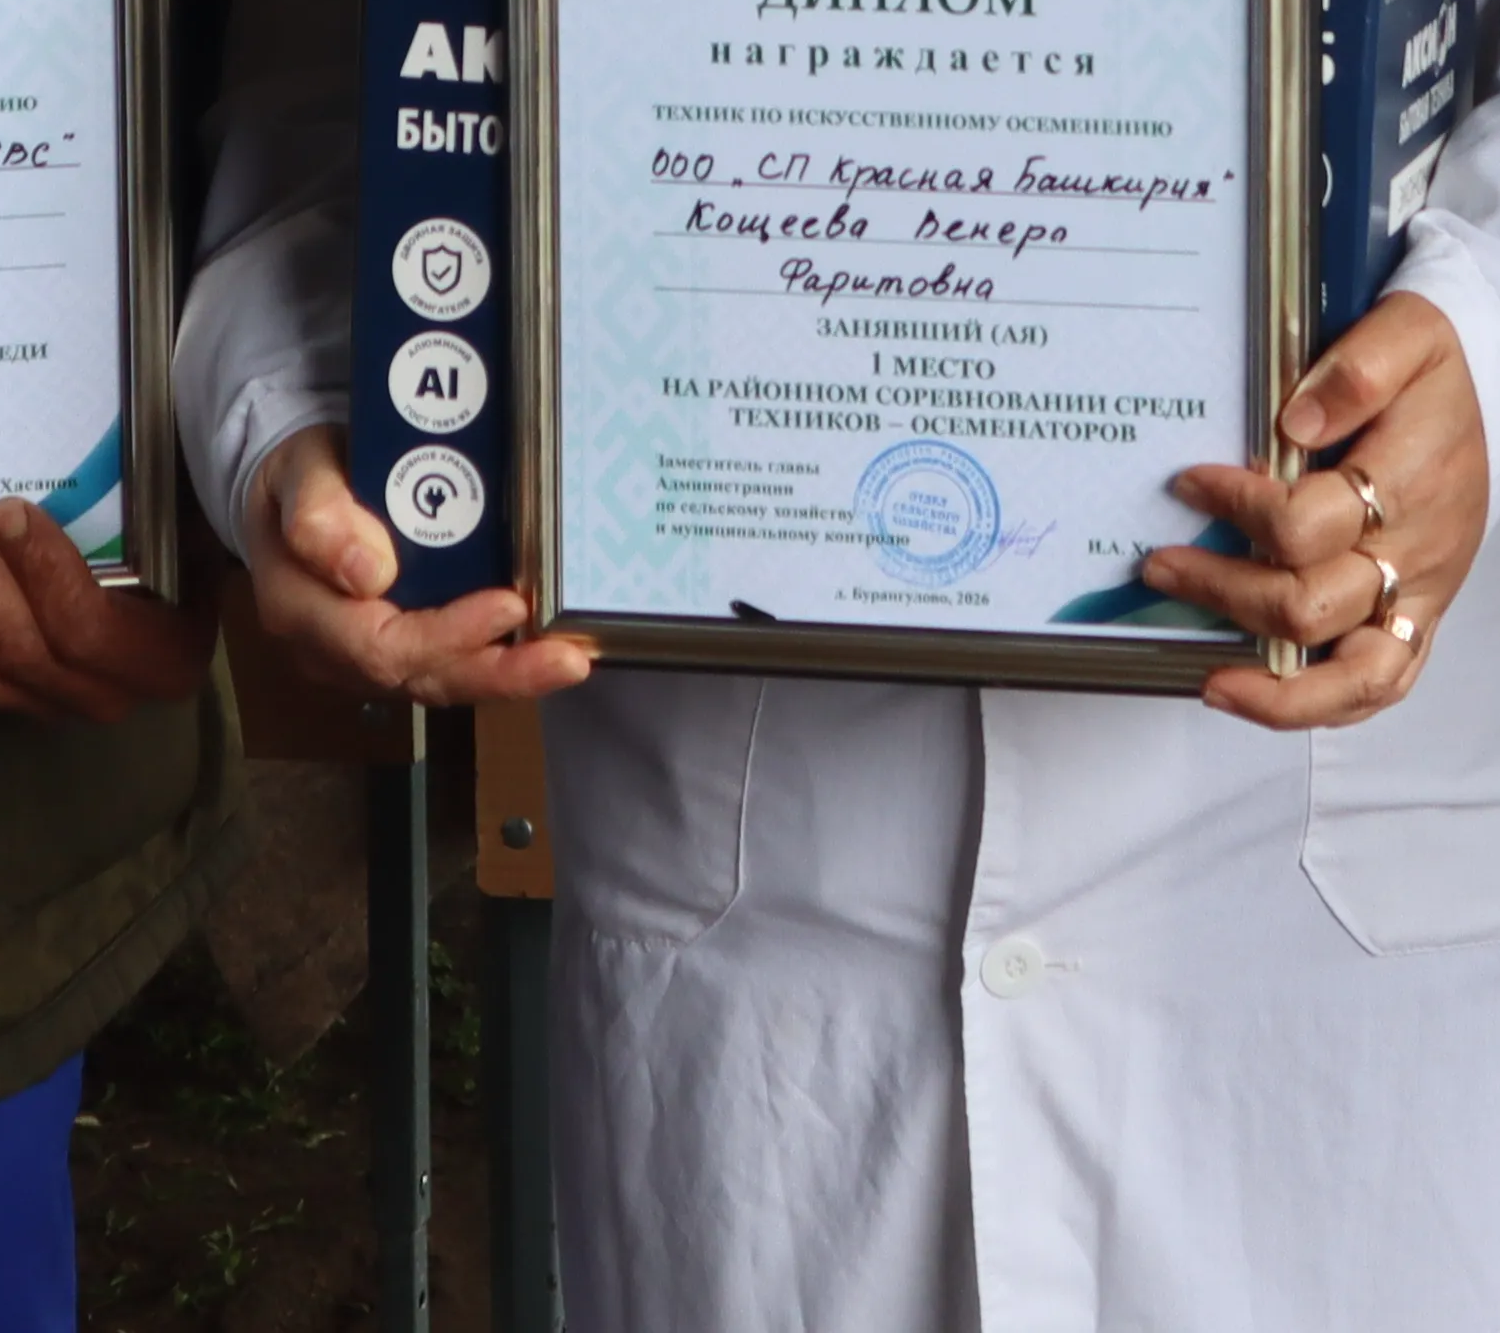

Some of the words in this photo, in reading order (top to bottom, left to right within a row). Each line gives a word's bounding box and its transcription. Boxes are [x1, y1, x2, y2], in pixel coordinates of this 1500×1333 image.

[400, 21, 503, 84] АК
[711, 42, 1094, 76] награждается
[397, 107, 504, 156] БЫТО
[652, 104, 745, 124] ТЕХНИК
[751, 107, 783, 124] ПО
[788, 108, 1001, 131] ИСКУССТВЕННОМУ
[1005, 116, 1173, 137] ОСЕМЕНЕНИЮ
[650, 153, 715, 183] ООО
[829, 157, 995, 201] Красная
[685, 199, 870, 243] Кощеева
[778, 256, 996, 307] Фаритовна
[816, 318, 982, 343] ЗАНЯВШИЙ
[990, 324, 1048, 347] (АЯ)
[872, 351, 881, 376] 1
[894, 356, 996, 380] МЕСТО
[662, 376, 700, 398] НА
[708, 377, 868, 404] РАЙОННОМ
[875, 386, 1106, 415] СОРЕВНОВАНИИ
[1113, 396, 1205, 421] СРЕДИ
[729, 407, 881, 432] ТЕХНИКОВ
[910, 415, 1137, 443] ОСЕМЕНАТОРОВ
[658, 453, 763, 473] Заместитель
[768, 461, 820, 476] главы
